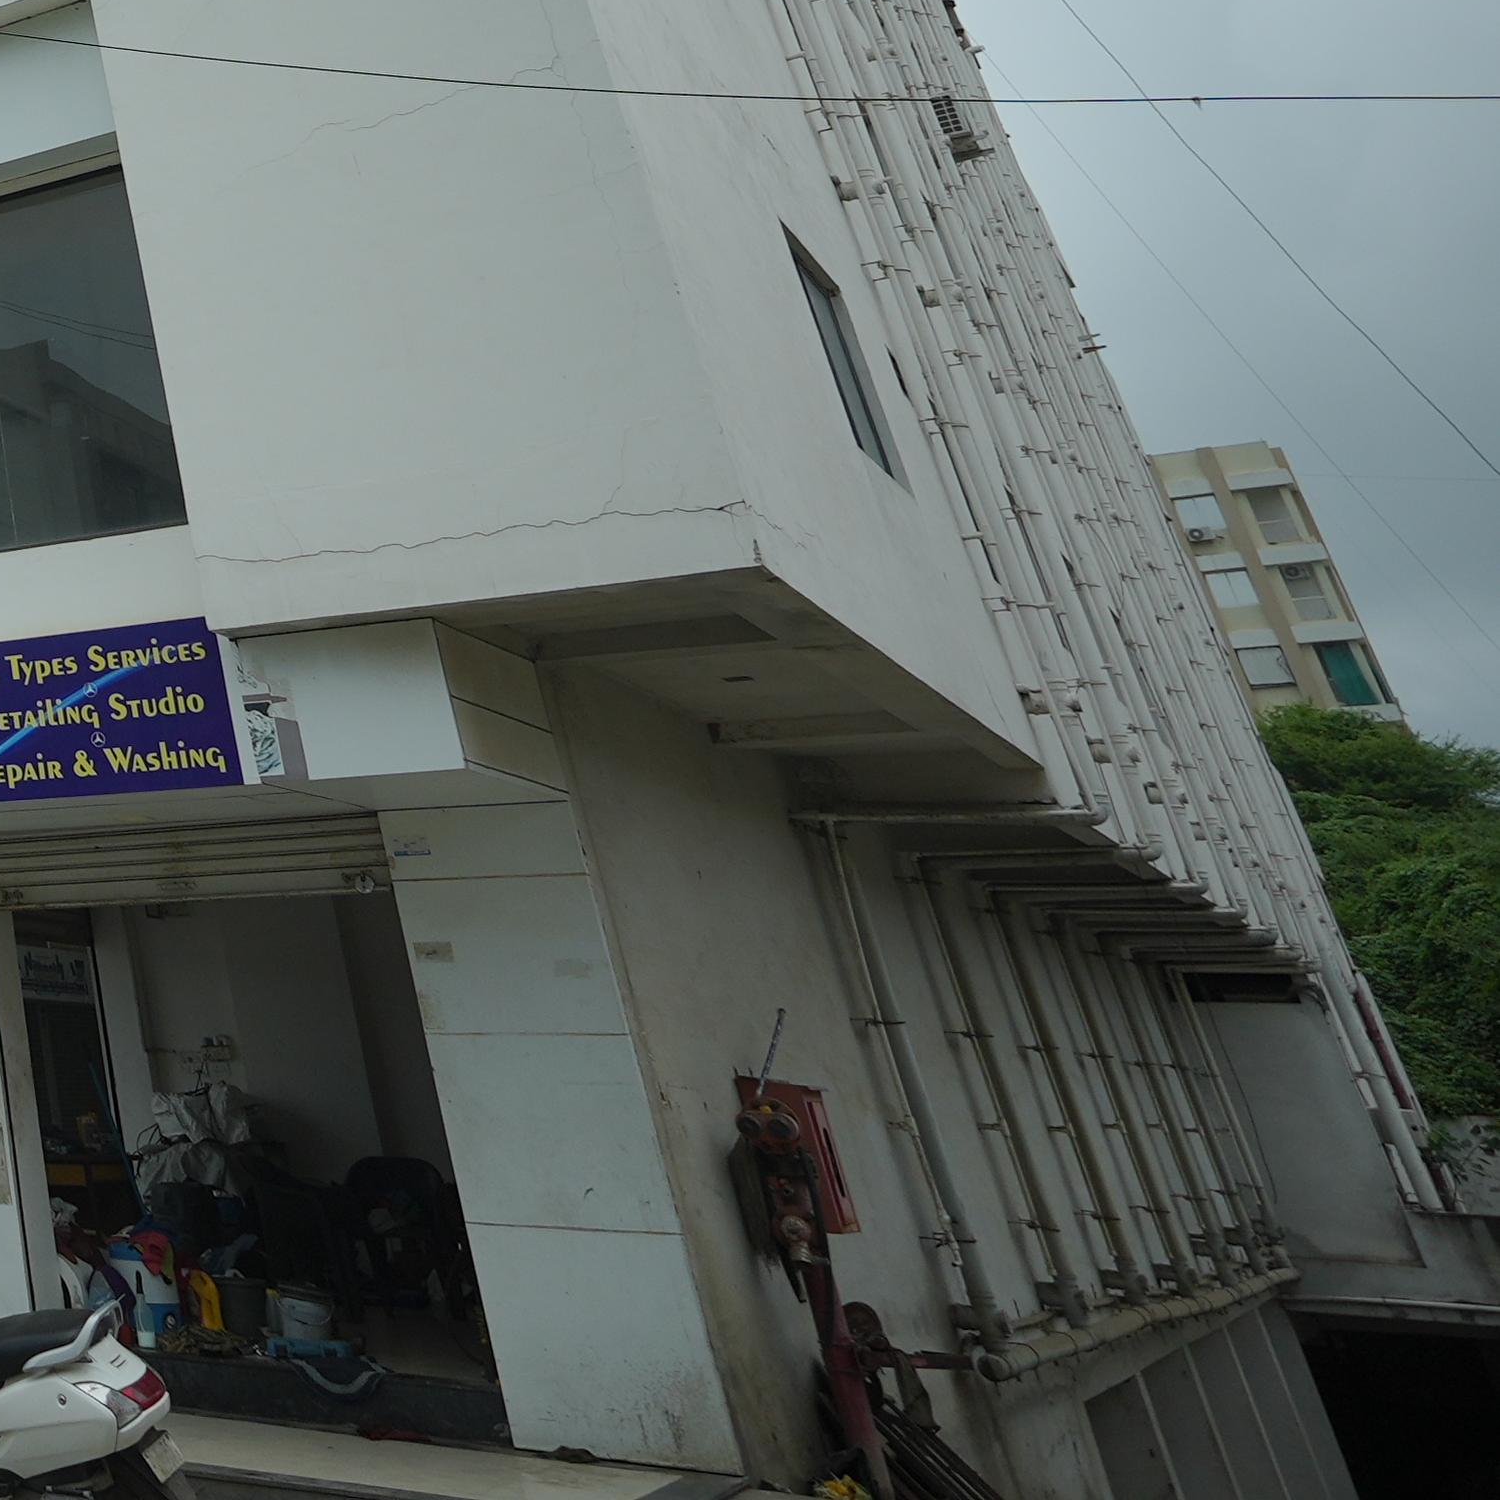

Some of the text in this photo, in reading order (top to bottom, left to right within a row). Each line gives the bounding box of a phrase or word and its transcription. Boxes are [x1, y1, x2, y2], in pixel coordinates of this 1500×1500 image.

[4, 652, 78, 686] Types
[71, 747, 98, 777] &
[102, 740, 227, 776] Washing
